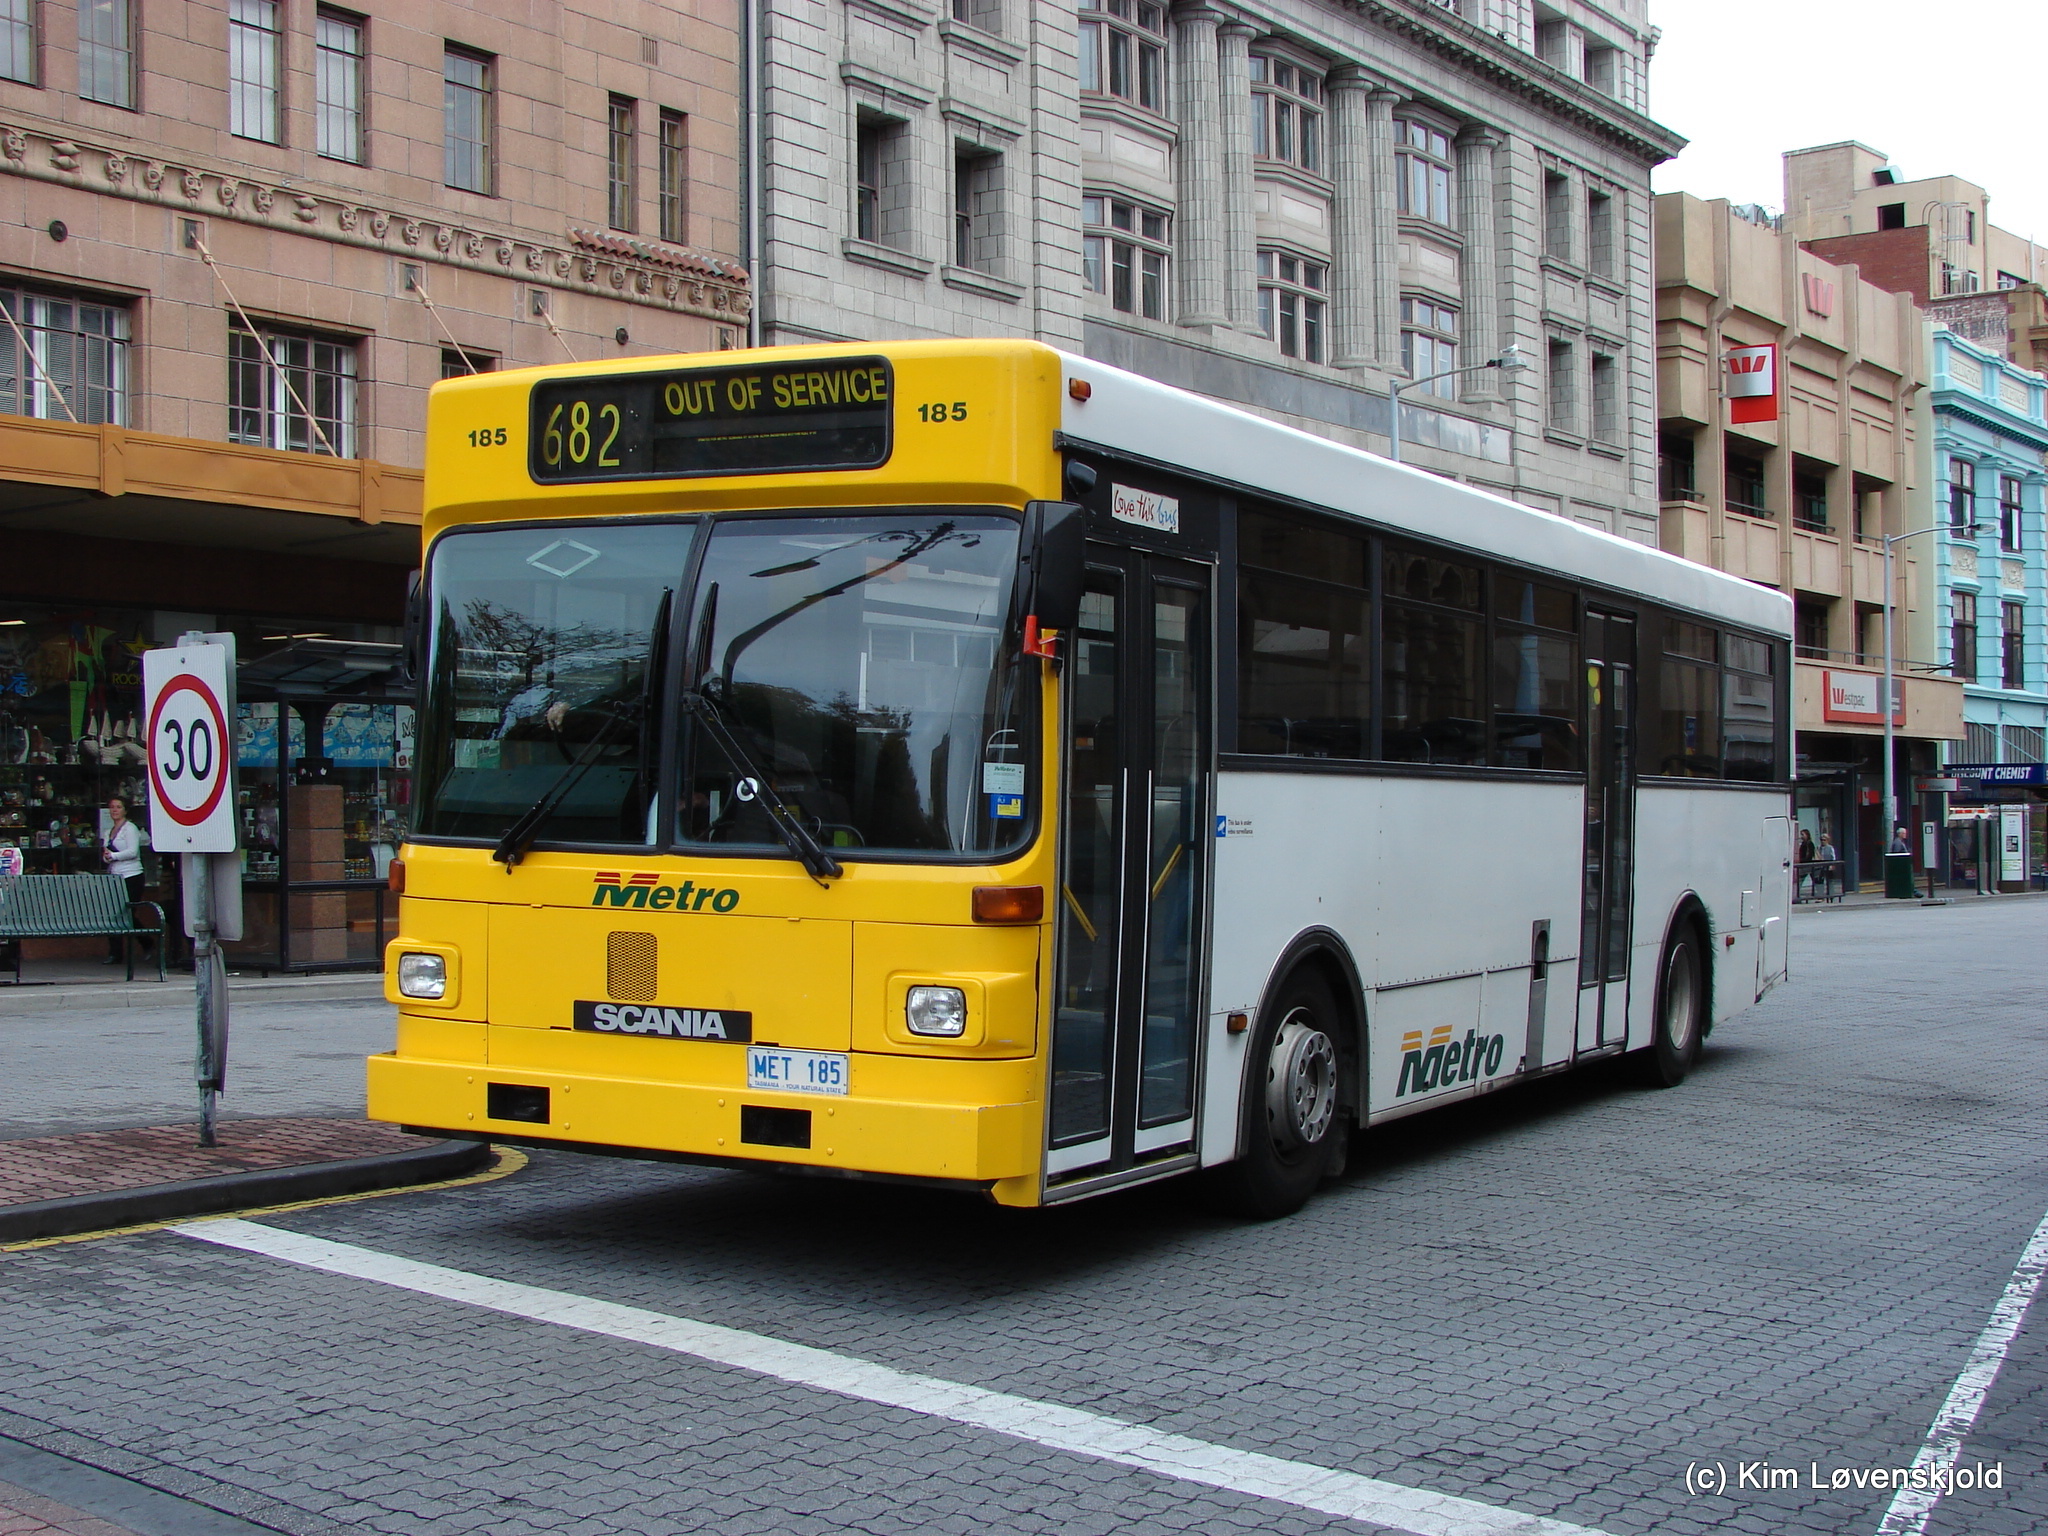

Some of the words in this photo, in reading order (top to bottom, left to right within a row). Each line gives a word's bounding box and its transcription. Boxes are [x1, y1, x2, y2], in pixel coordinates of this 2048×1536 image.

[665, 380, 716, 415] OUT
[727, 376, 762, 411] OF
[773, 367, 888, 408] SERVICE
[918, 402, 968, 422] 185
[468, 427, 507, 448] 185
[543, 401, 620, 467] 682
[1137, 494, 1154, 522] this
[1157, 499, 1177, 526] bus
[1832, 687, 1865, 709] Westpac
[163, 718, 213, 781] 30
[1995, 766, 2032, 780] CHEMIST
[592, 872, 740, 913] Metro
[593, 1003, 728, 1040] SCANIA
[754, 1054, 792, 1080] MET
[808, 1059, 840, 1085] 185
[1396, 1024, 1504, 1098] Metro
[801, 1084, 824, 1093] NATURAL
